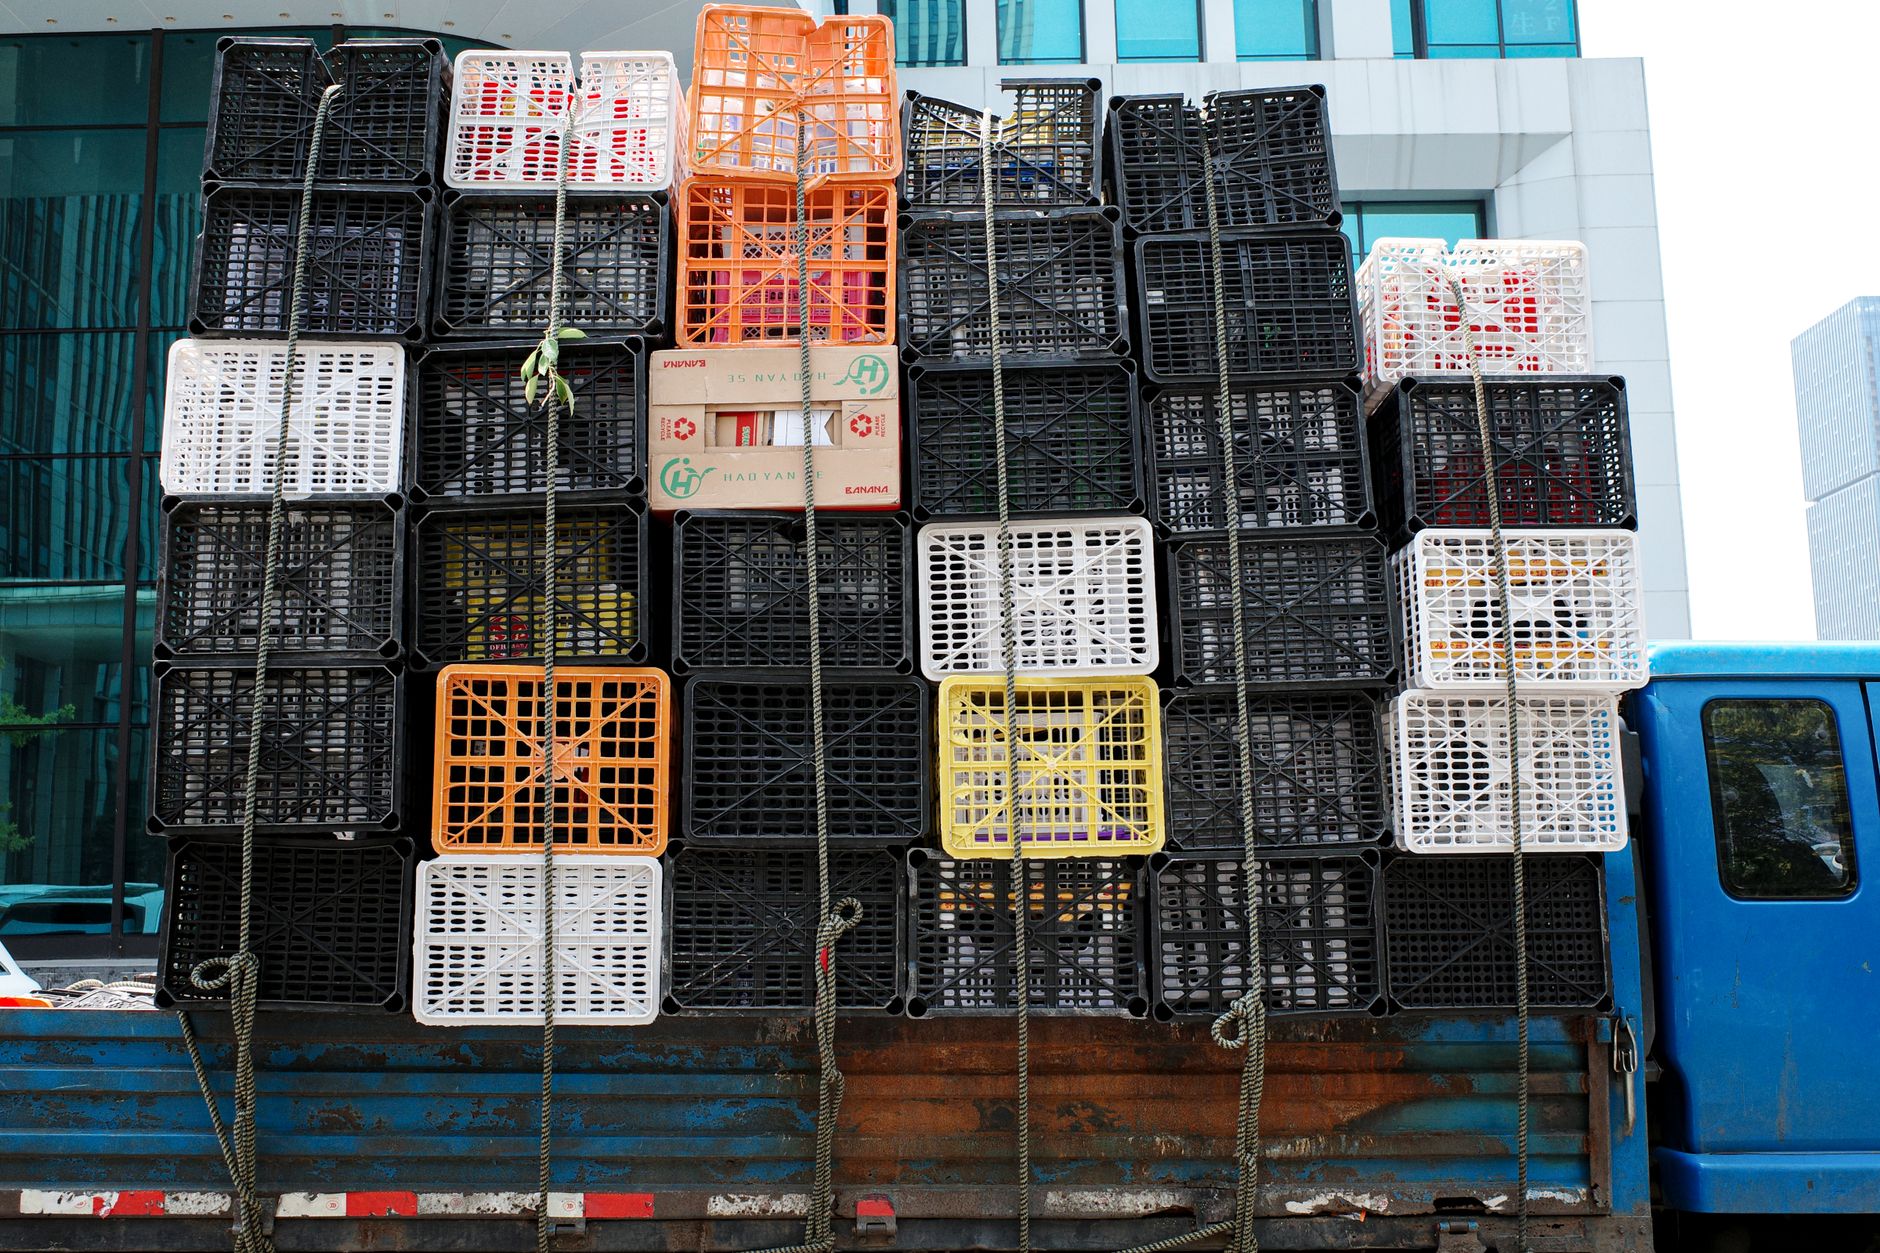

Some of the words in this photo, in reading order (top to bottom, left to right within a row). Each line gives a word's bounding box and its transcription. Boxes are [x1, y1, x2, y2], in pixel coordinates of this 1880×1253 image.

[663, 360, 706, 368] BANANA
[728, 374, 746, 383] SE
[755, 373, 786, 382] YAN
[723, 473, 757, 481] HAO
[764, 472, 796, 480] YAN
[845, 485, 889, 494] BANANA
